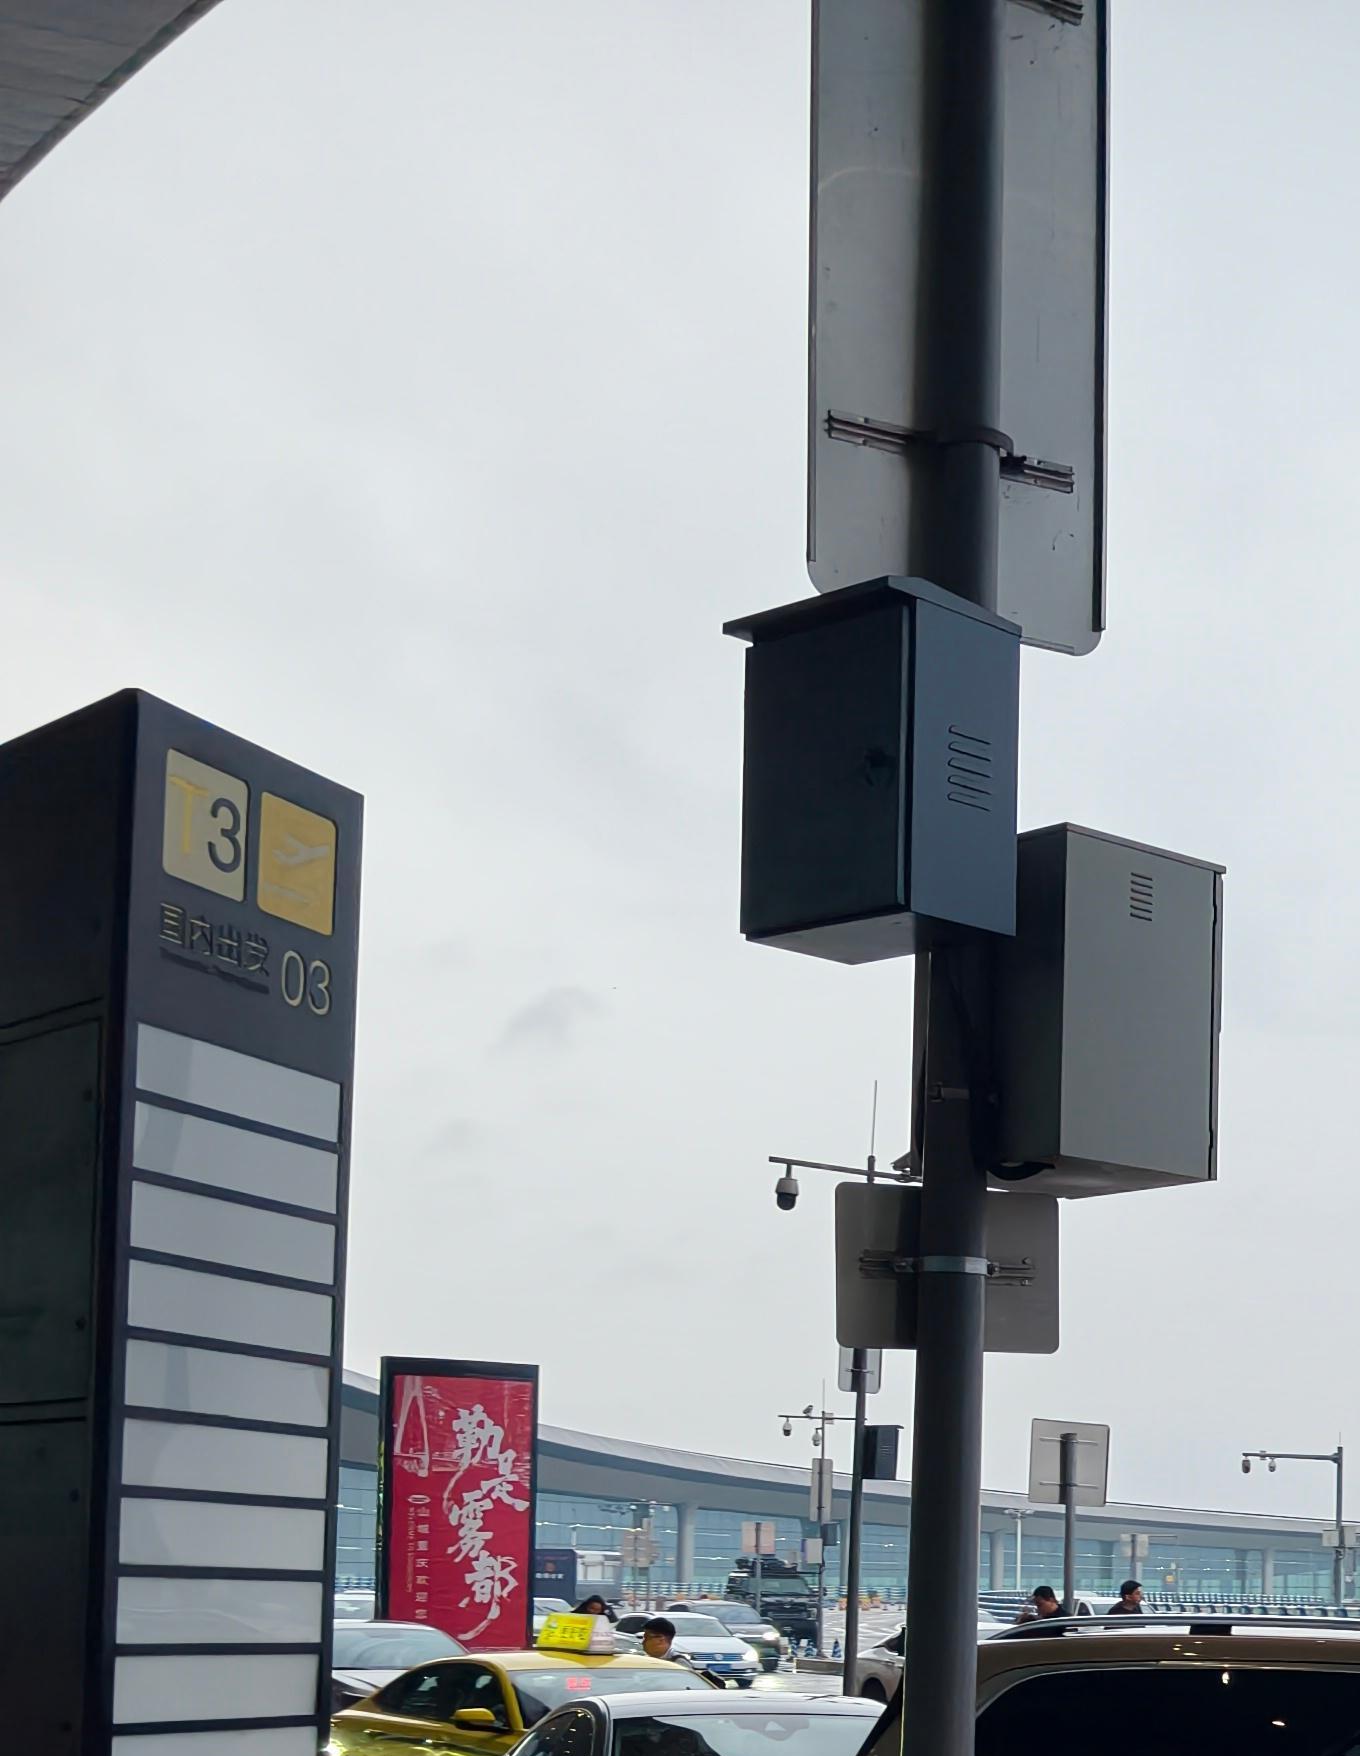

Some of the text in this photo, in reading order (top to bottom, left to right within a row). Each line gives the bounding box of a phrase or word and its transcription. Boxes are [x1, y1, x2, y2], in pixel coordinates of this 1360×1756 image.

[168, 774, 242, 873] T3
[159, 902, 270, 978] 国内出发
[281, 950, 333, 1016] 03
